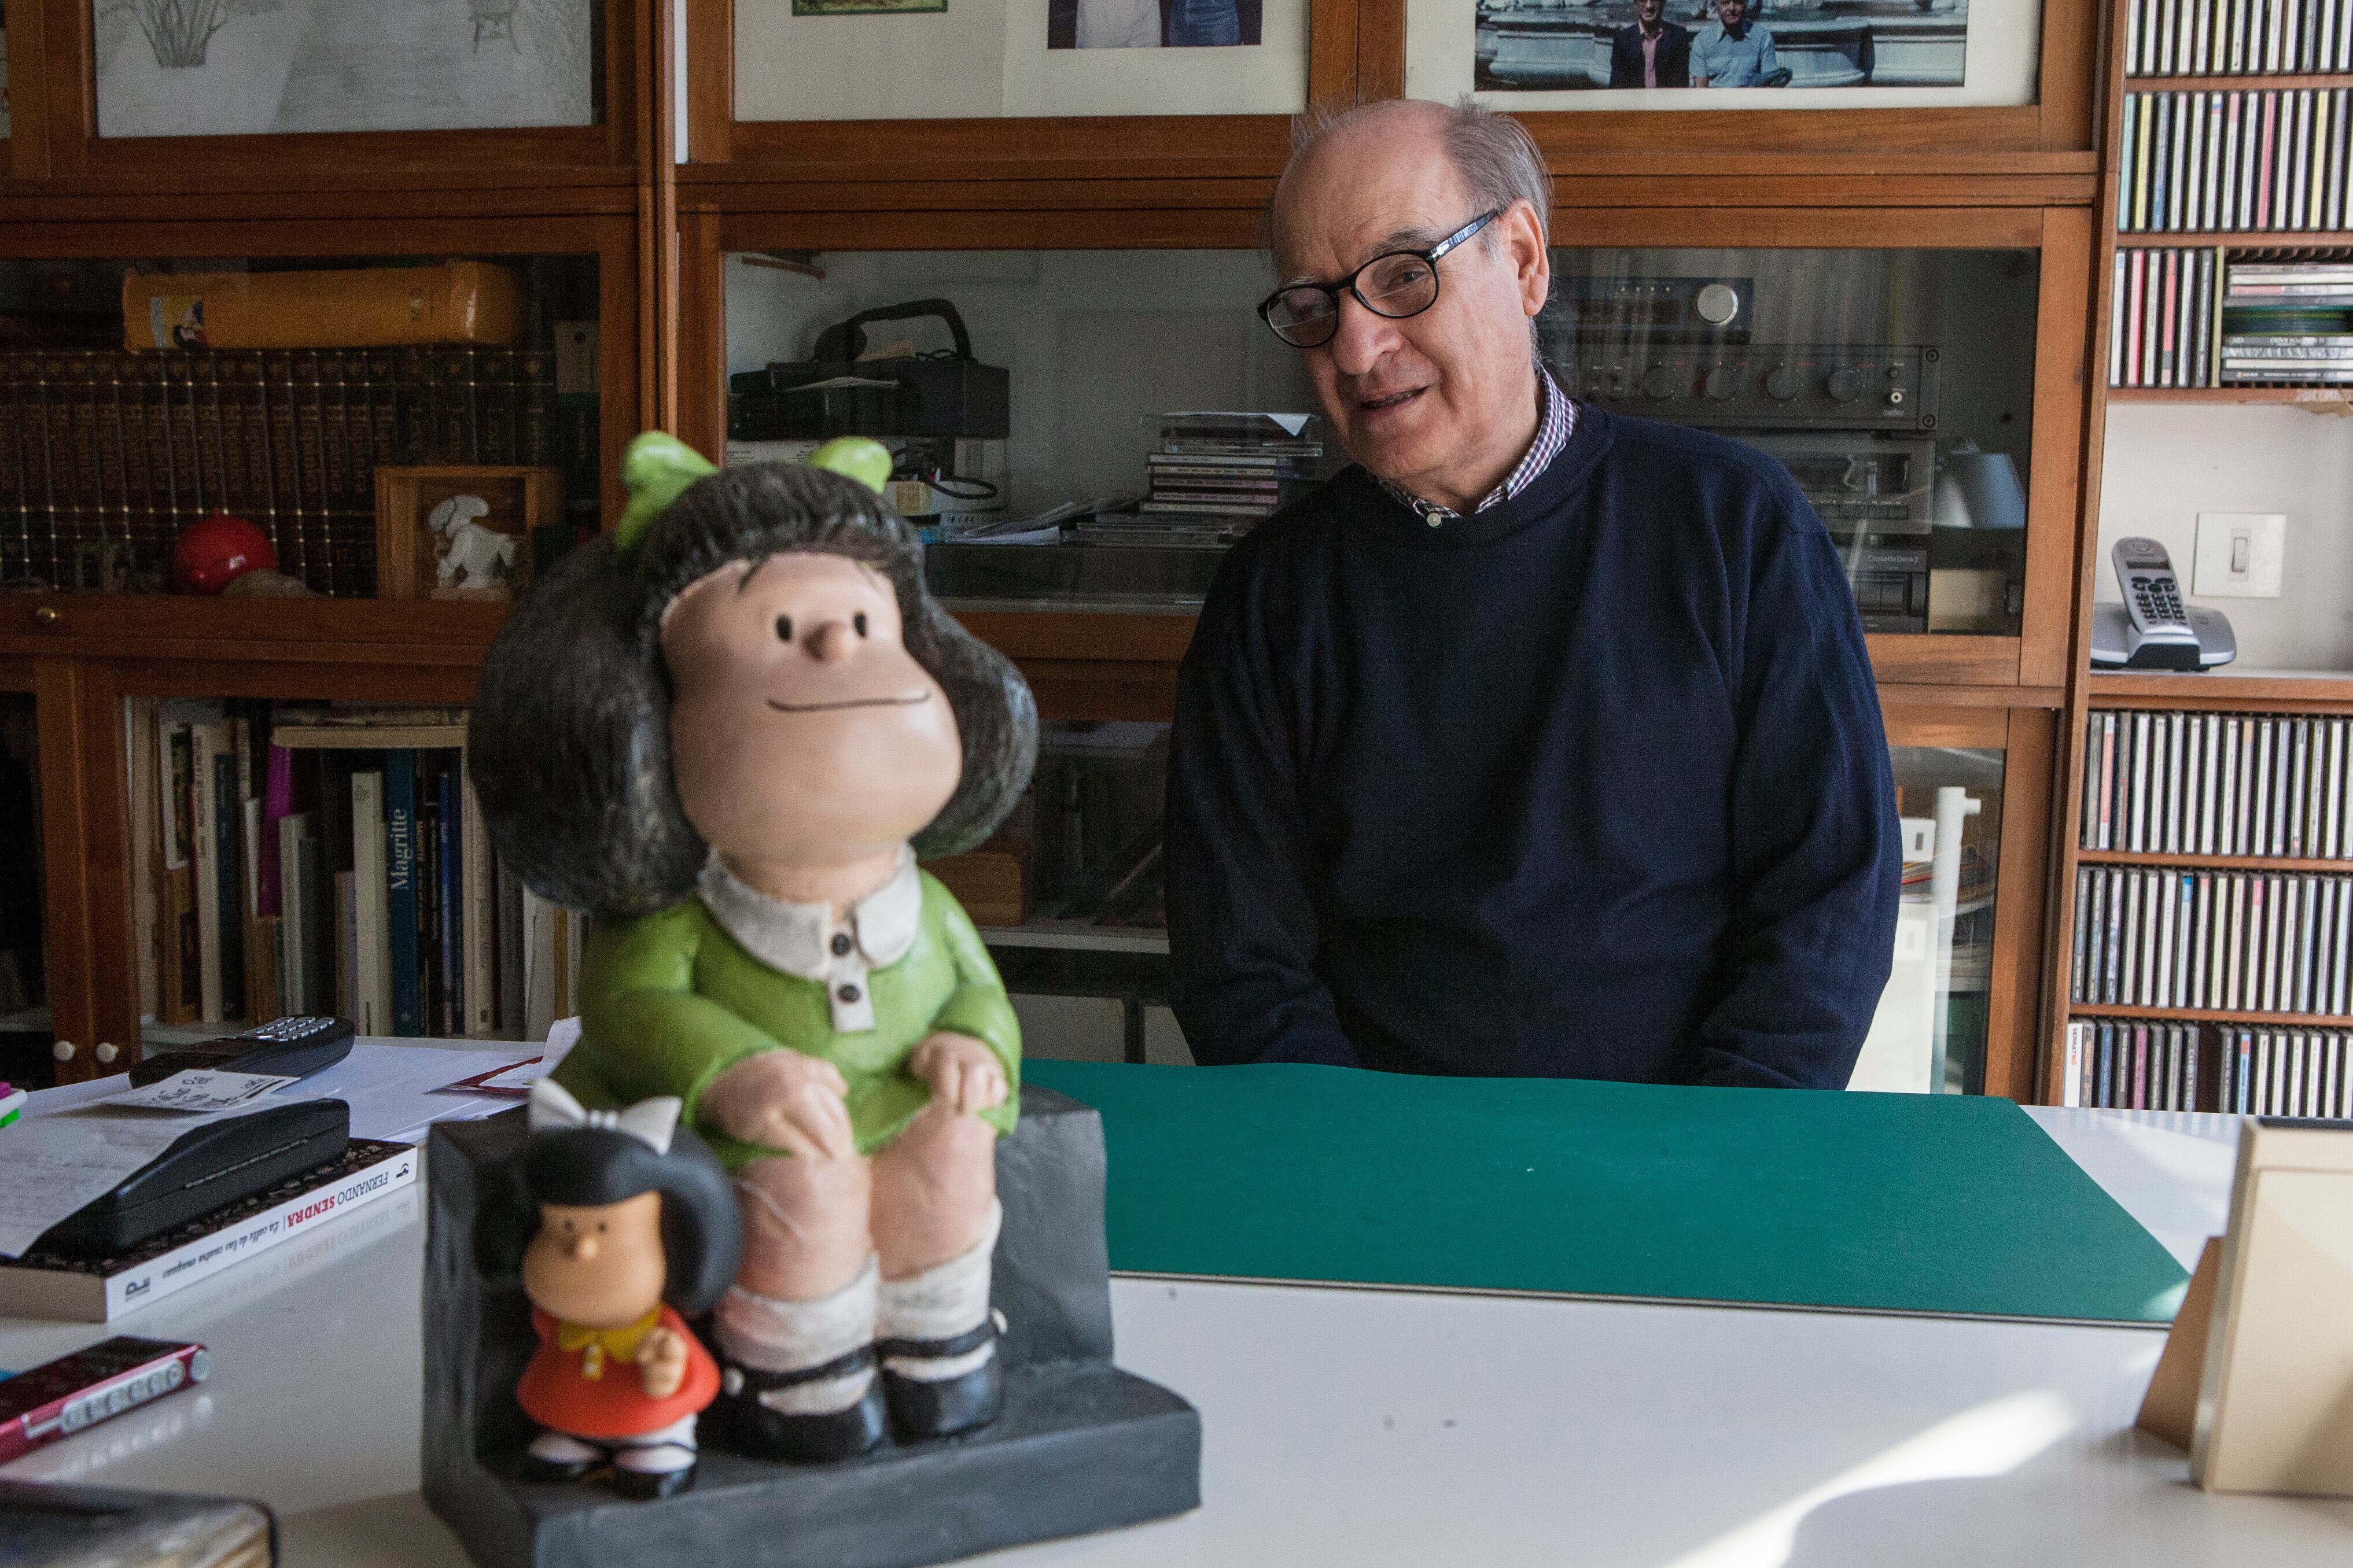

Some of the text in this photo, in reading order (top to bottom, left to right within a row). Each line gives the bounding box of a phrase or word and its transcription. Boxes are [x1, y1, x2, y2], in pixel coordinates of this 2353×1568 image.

[391, 808, 413, 891] Magritte
[337, 1172, 389, 1205] FERNANDO
[286, 1195, 335, 1228] SENDRA
[249, 1226, 267, 1244] calle
[270, 1221, 280, 1235] La
[225, 1239, 237, 1252] las
[238, 1235, 248, 1248] de
